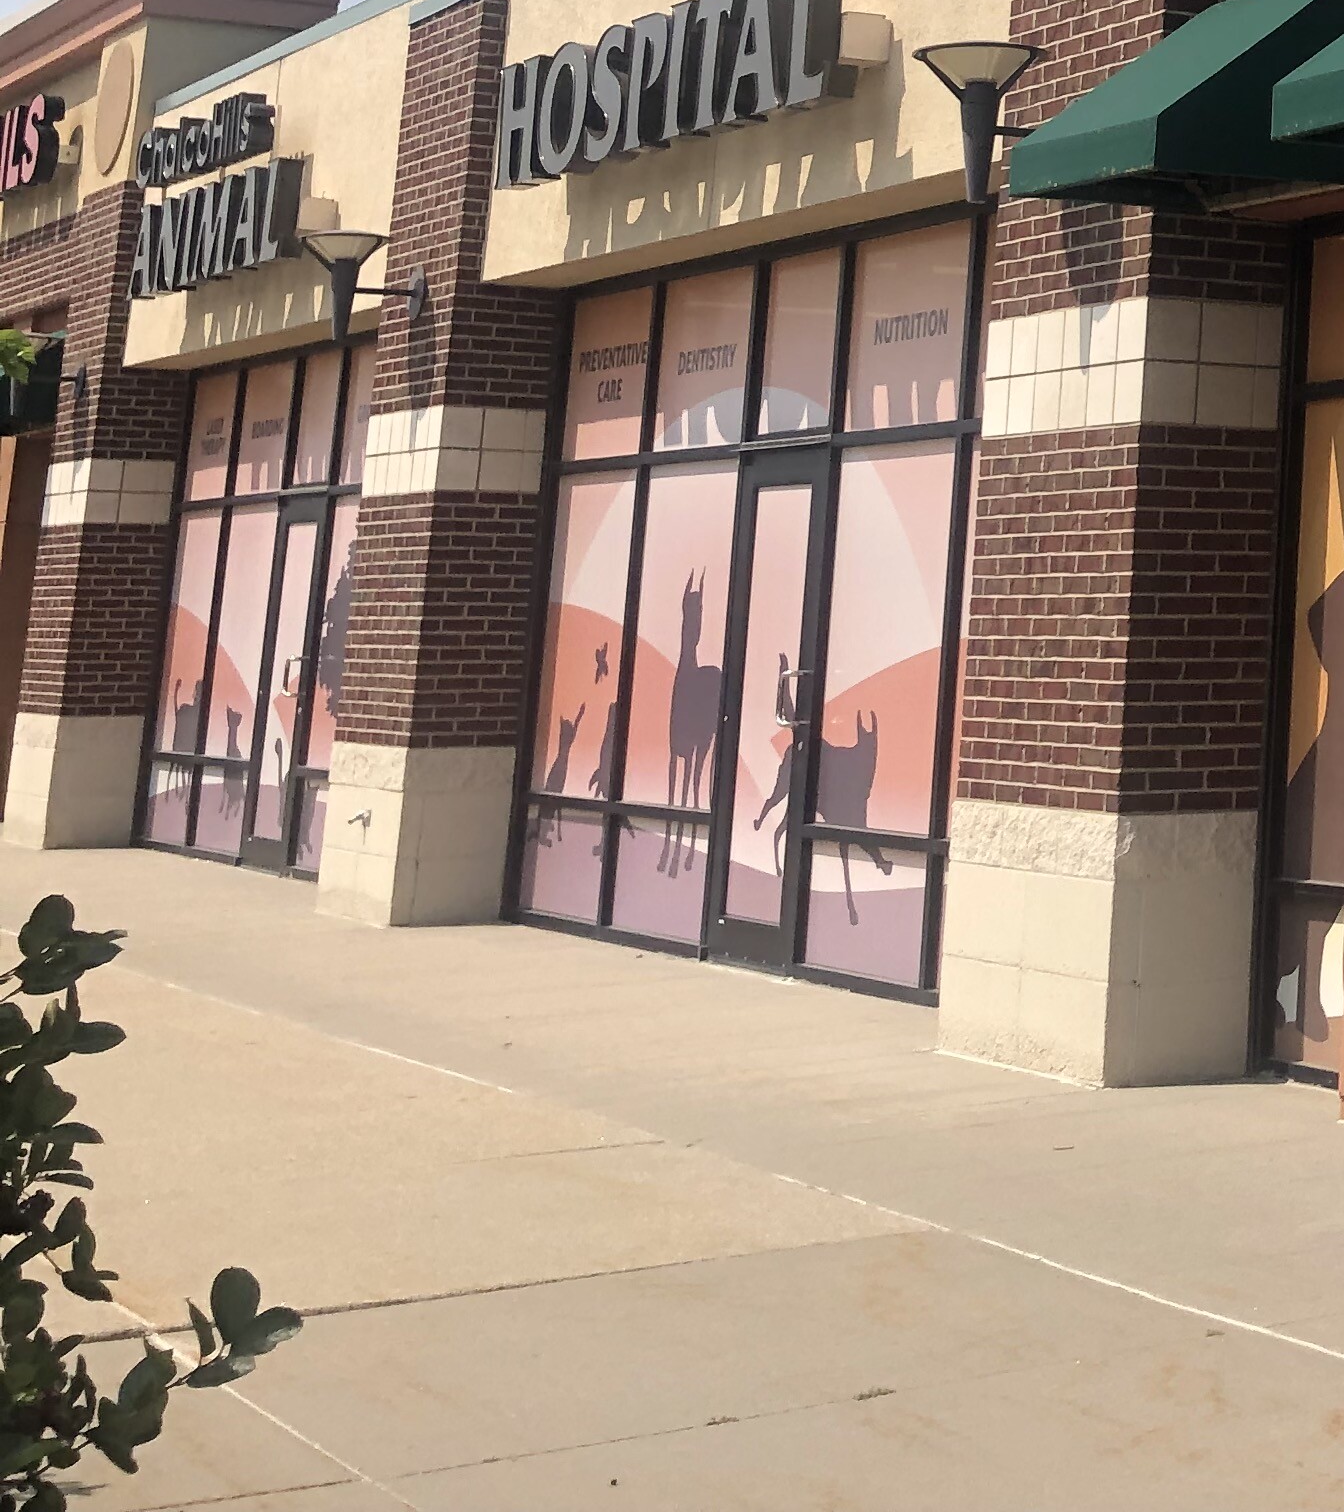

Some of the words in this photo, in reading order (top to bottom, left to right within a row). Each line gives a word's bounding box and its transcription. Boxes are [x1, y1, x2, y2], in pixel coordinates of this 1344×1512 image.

[126, 157, 282, 301] ANIMAL
[873, 307, 950, 346] NUTRITION
[578, 341, 650, 374] PREVENTATIVE
[677, 343, 738, 376] DENTISTRY
[597, 378, 623, 403] CARE
